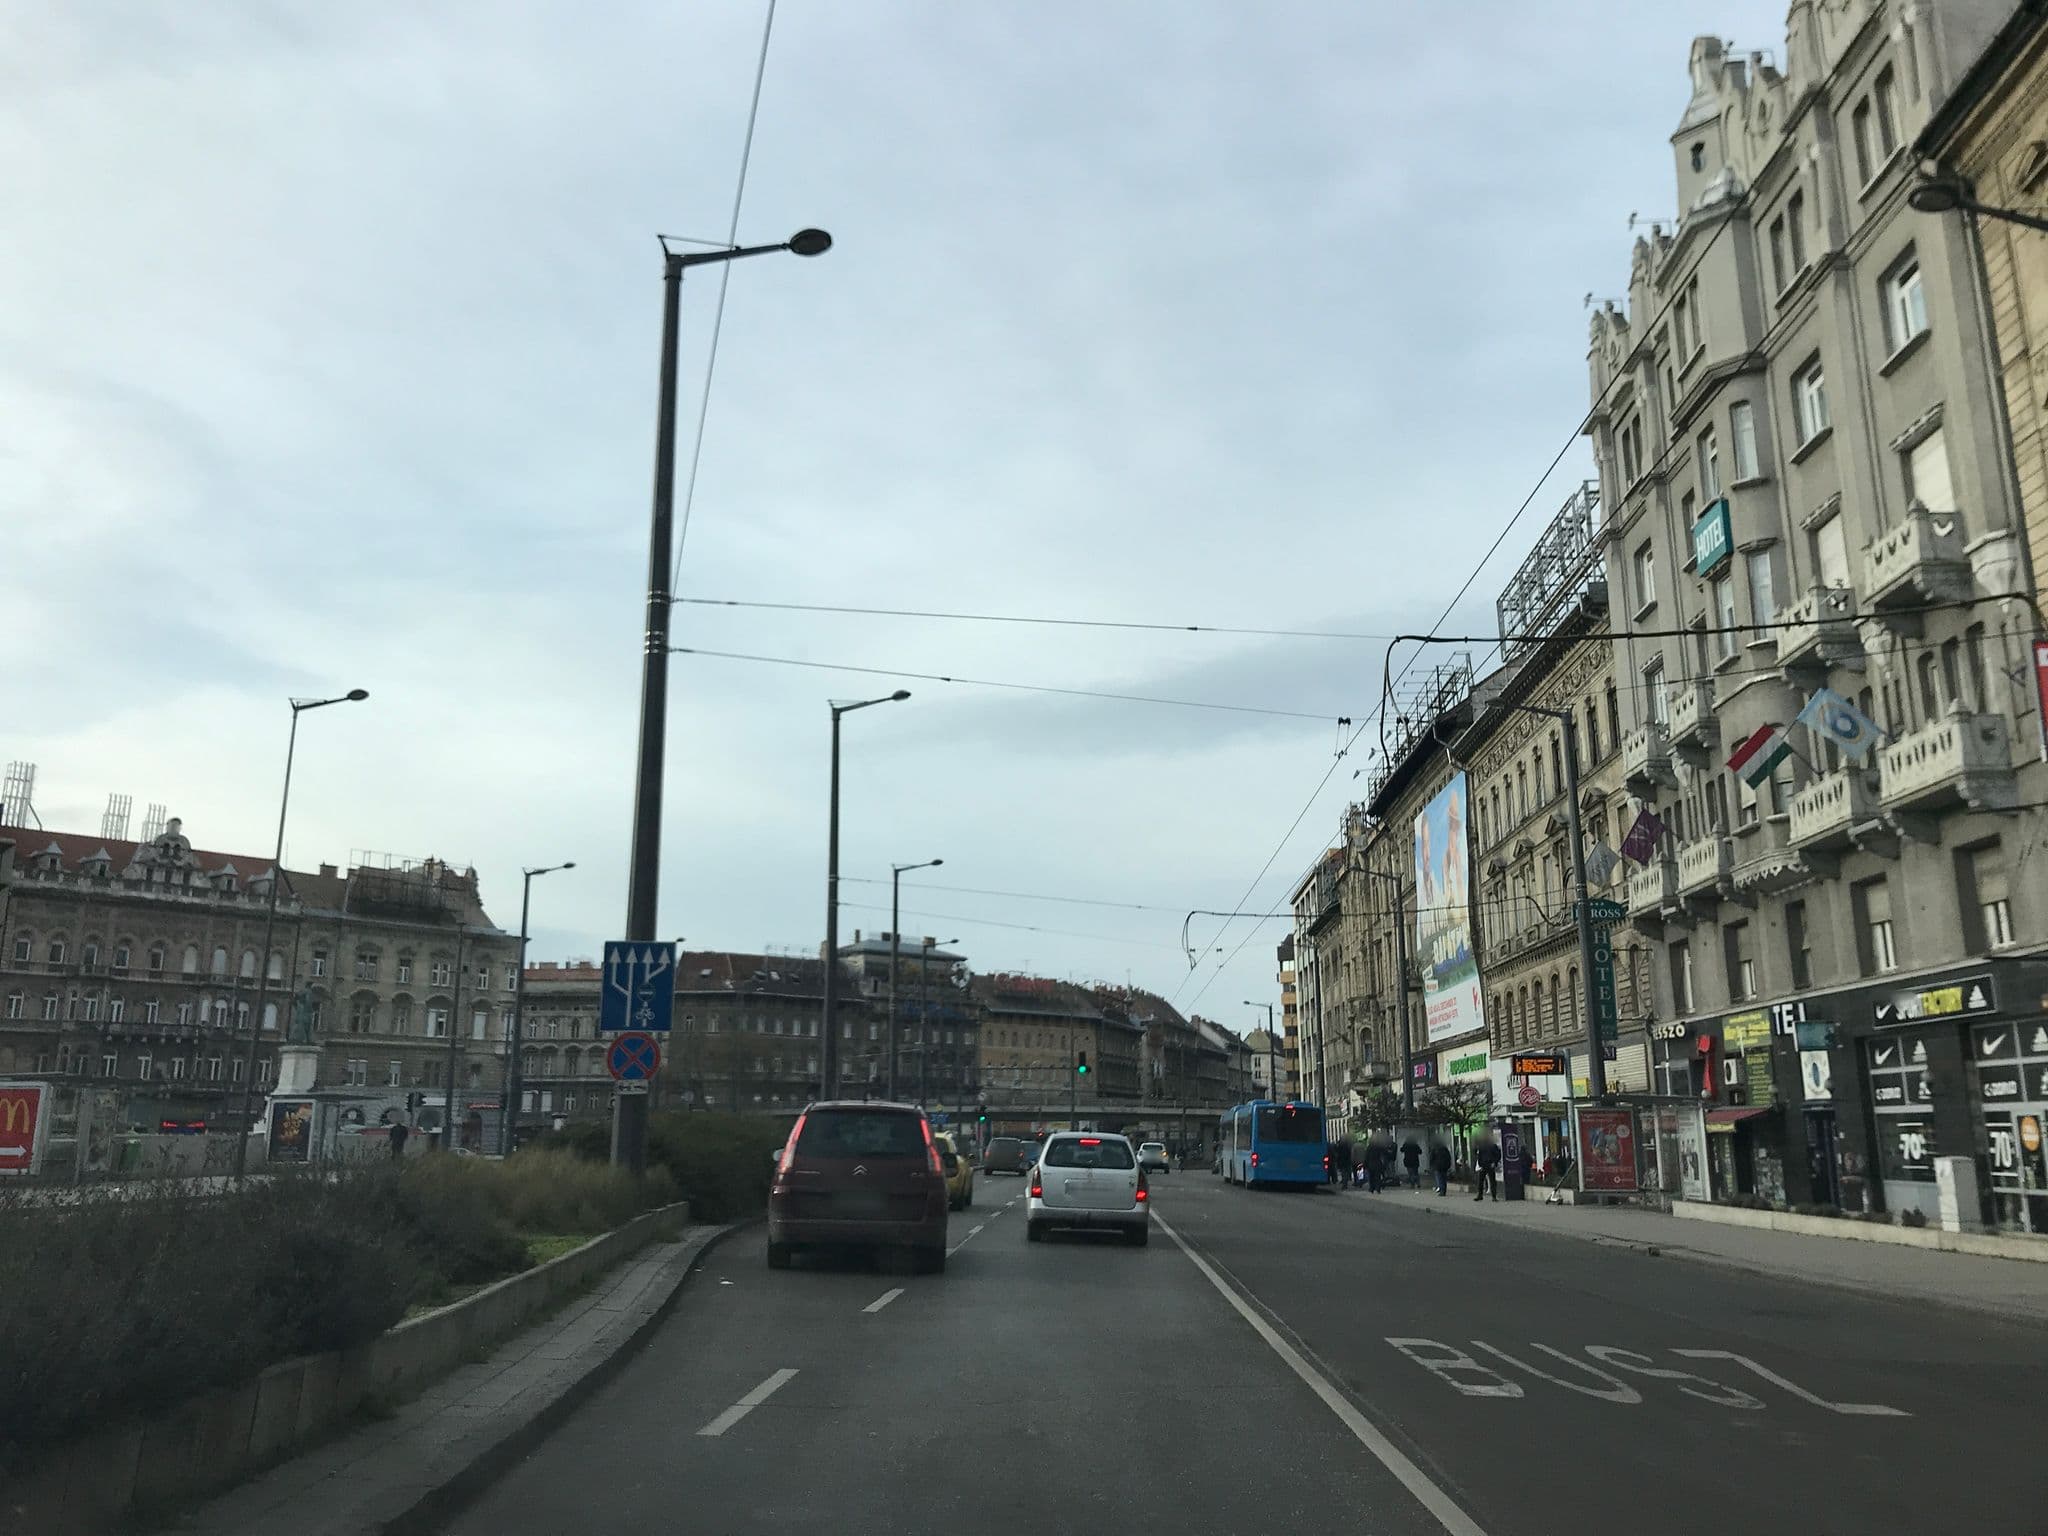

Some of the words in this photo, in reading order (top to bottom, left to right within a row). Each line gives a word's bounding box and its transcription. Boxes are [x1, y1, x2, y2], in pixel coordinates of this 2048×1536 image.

[1696, 516, 1725, 564] HOTEL
[1594, 931, 1613, 1019] HOTEL
[1384, 1336, 1913, 1416] BUSZ
